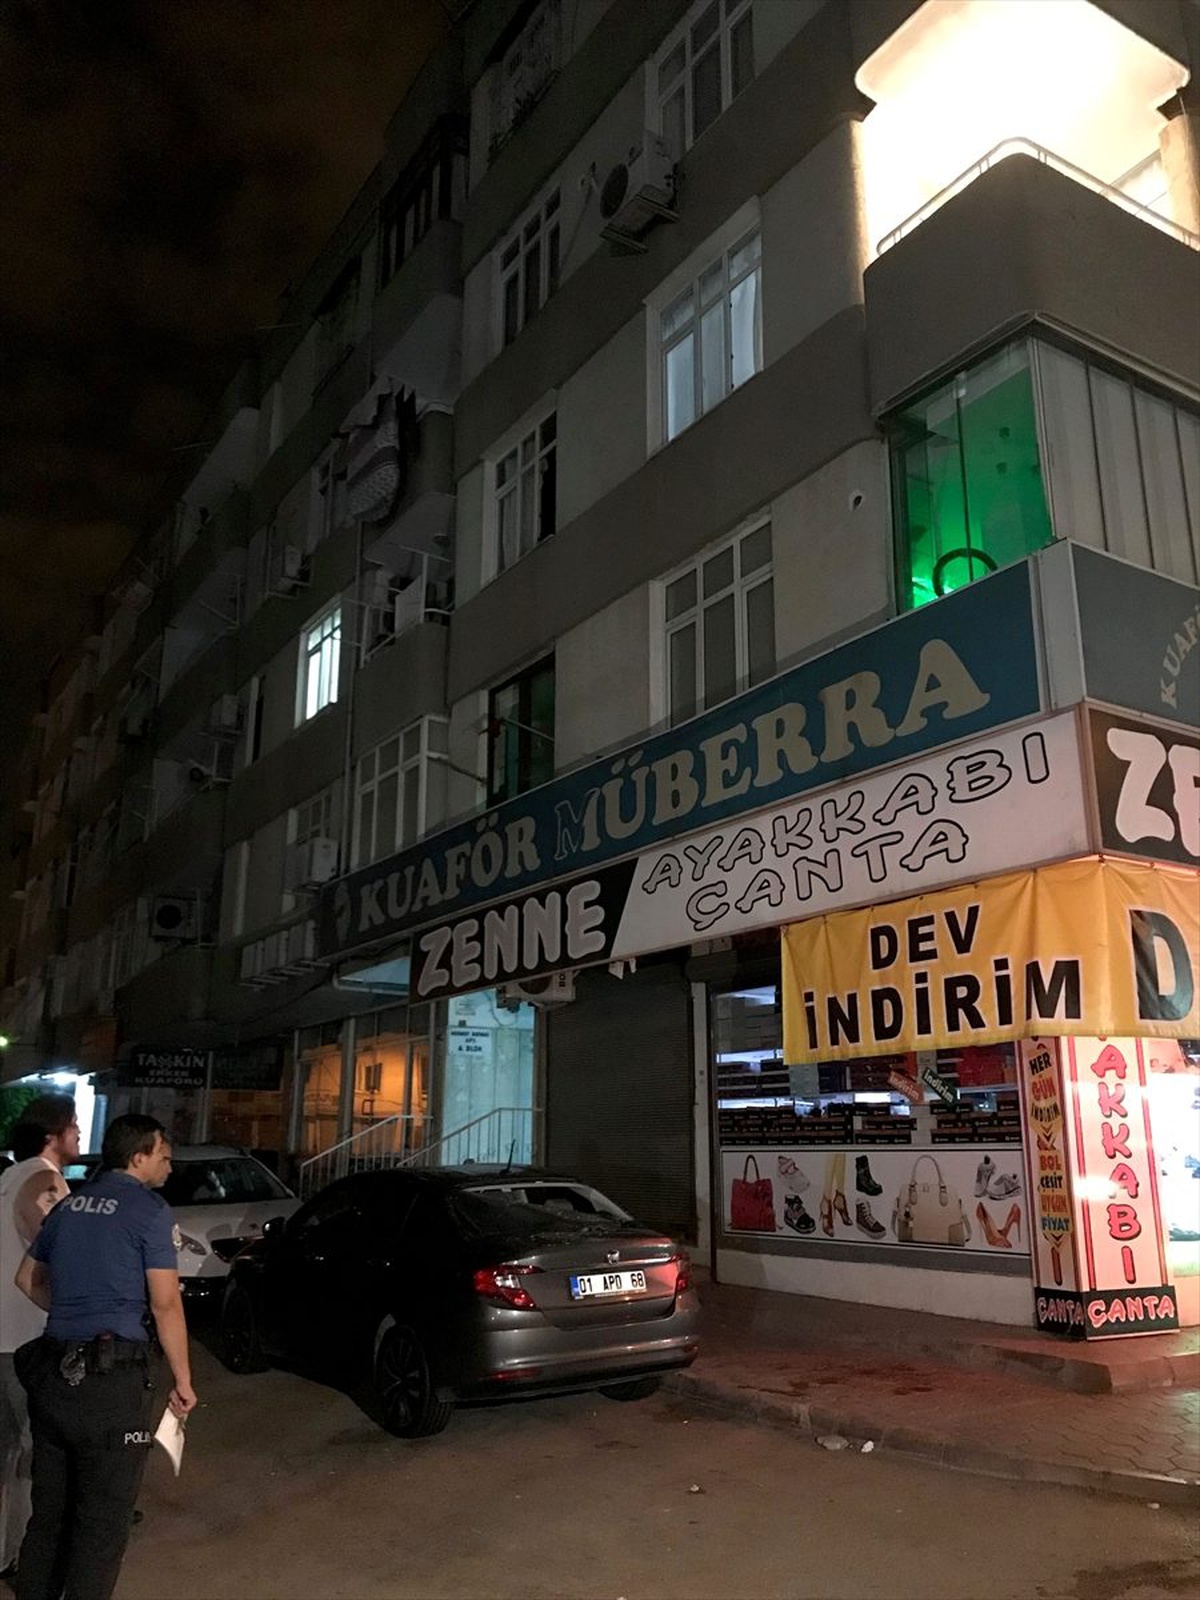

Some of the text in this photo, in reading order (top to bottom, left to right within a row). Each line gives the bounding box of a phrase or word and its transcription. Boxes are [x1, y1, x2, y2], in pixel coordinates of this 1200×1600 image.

[358, 639, 991, 932] KUAFÖR MÜBERRA
[642, 731, 1050, 894] AYAKKABI
[685, 819, 970, 931] ÇANTA
[416, 880, 606, 997] ZENNE
[871, 904, 980, 970] DEV
[1029, 1051, 1052, 1076] HER
[1040, 1155, 1062, 1171] BOL
[1090, 1036, 1143, 1284] AKKABI
[579, 1277, 593, 1293] 01
[630, 1272, 645, 1288] 68
[1036, 1297, 1085, 1325] ÇANTA
[1087, 1294, 1176, 1329] ÇANTA
